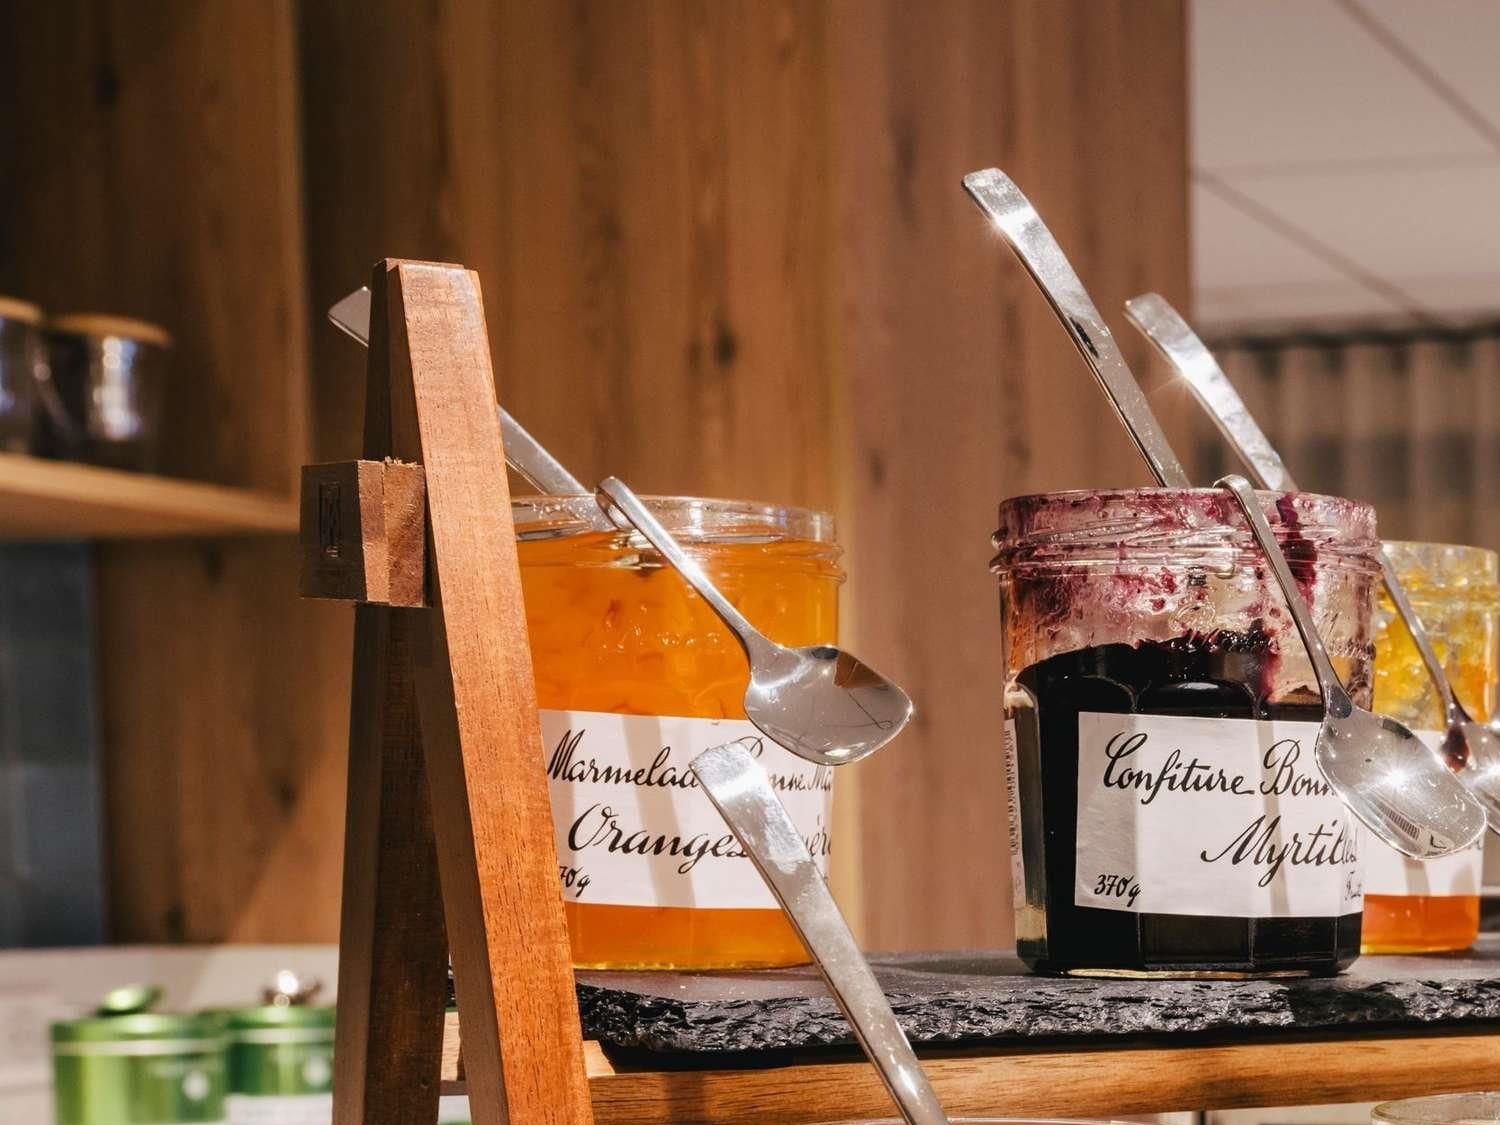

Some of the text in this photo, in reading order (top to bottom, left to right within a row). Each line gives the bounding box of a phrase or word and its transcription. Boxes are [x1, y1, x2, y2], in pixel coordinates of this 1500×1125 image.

[547, 728, 701, 788] Marmela
[1103, 731, 1336, 805] Confiture Bonn
[559, 865, 592, 898] 70g
